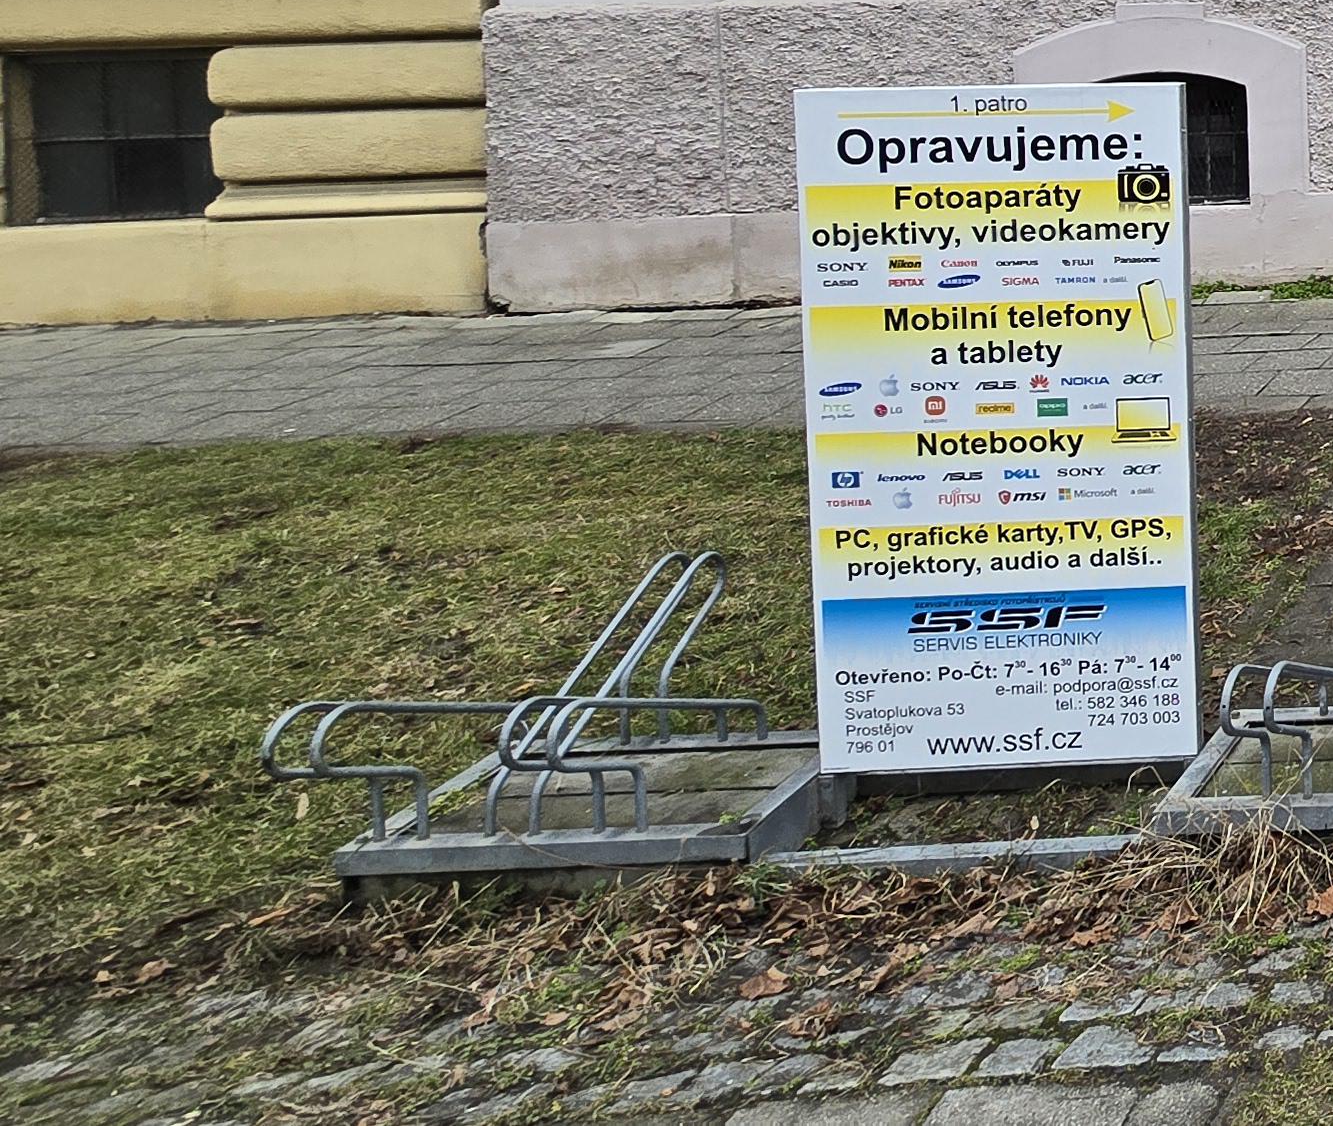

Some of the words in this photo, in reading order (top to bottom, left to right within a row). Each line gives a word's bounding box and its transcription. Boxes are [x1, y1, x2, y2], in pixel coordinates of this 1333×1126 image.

[950, 96, 968, 113] 1.
[975, 96, 1027, 115] patro
[837, 126, 1143, 173] Opravujeme:
[894, 184, 1081, 213] Fotoaparáty
[812, 223, 961, 251] objektivy,
[972, 220, 1170, 246] videokamery
[817, 262, 867, 272] SONY
[888, 260, 922, 269] Nikon
[941, 260, 978, 268] Canon
[1114, 256, 1160, 264] Panasonic
[823, 279, 859, 287] CASIO
[888, 278, 925, 287] PENTAX
[1001, 277, 1039, 286] SIGMA
[1055, 276, 1095, 284] TAMRON
[884, 305, 998, 332] Mobilní
[1007, 304, 1131, 333] telefony
[931, 347, 947, 365] a
[958, 340, 1062, 367] tablety
[911, 382, 960, 391] SONY
[975, 381, 1017, 391] ASUS
[1061, 377, 1110, 386] NOKIA
[1123, 373, 1162, 385] acer
[978, 405, 1011, 413] realme
[917, 429, 1083, 457] Notebooky
[878, 474, 926, 483] lenovo
[942, 471, 983, 482] ASUS
[1004, 469, 1040, 480] DELL
[1057, 467, 1105, 477] SONY
[1123, 464, 1161, 475] acer
[826, 499, 872, 507] TOSHIBA
[938, 488, 981, 507] FUJITSU
[1013, 492, 1046, 502] msi
[1074, 488, 1118, 498] Microsoft
[835, 529, 879, 551] PC,
[887, 524, 989, 551] grafické
[1110, 518, 1172, 541] GPS,
[848, 556, 981, 581] projektory,
[990, 552, 1059, 572] audio
[1068, 555, 1081, 568] a
[907, 605, 1107, 634] SSF
[913, 636, 977, 653] SERVIS
[985, 631, 1102, 649] ELEKTRONIKY
[835, 669, 931, 685] Otevřeno:
[938, 661, 997, 681] Po-Čt:
[1078, 659, 1108, 675] Pá:
[995, 681, 1048, 696] e-mail:
[1053, 676, 1178, 696] podpora@ssf.cz
[844, 690, 875, 703] SSF
[1056, 698, 1082, 711] tel.:
[1087, 697, 1115, 709] 582
[1120, 695, 1147, 708] 346
[1153, 693, 1180, 706] 188
[845, 705, 942, 721] Svatoplukova
[947, 703, 965, 715] 53
[1088, 714, 1115, 726] 724
[1121, 713, 1148, 725] 703
[1153, 711, 1180, 724] 003
[846, 724, 913, 737] Prostějov
[847, 742, 873, 754] 796
[878, 741, 895, 752] 01
[927, 728, 1082, 755] www.ssf.cz
